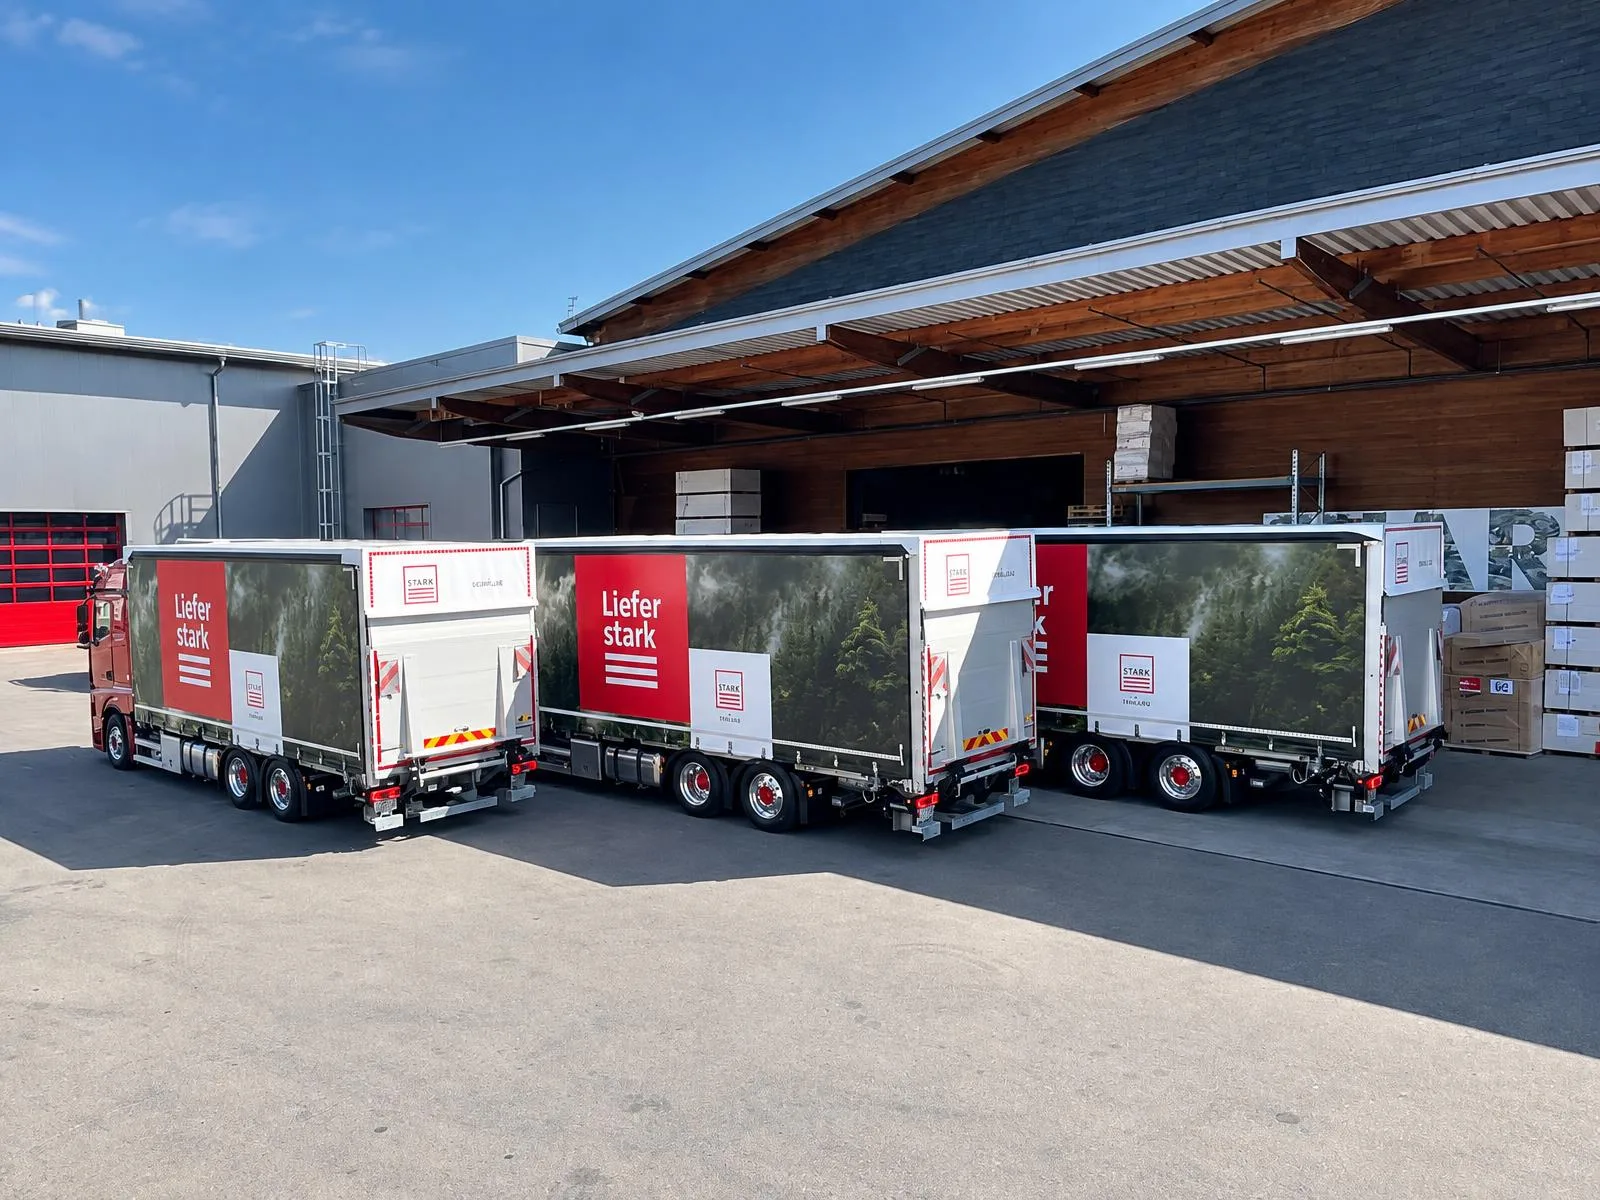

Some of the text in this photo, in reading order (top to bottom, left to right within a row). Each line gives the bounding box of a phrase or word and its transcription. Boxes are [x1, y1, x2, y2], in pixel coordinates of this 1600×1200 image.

[407, 578, 434, 587] STARK
[949, 568, 968, 578] STARK
[174, 592, 211, 622] Liefer
[602, 589, 662, 619] Liefer
[176, 622, 210, 650] stark
[603, 620, 657, 649] stark
[1123, 667, 1151, 677] STARK
[718, 683, 741, 693] STARK
